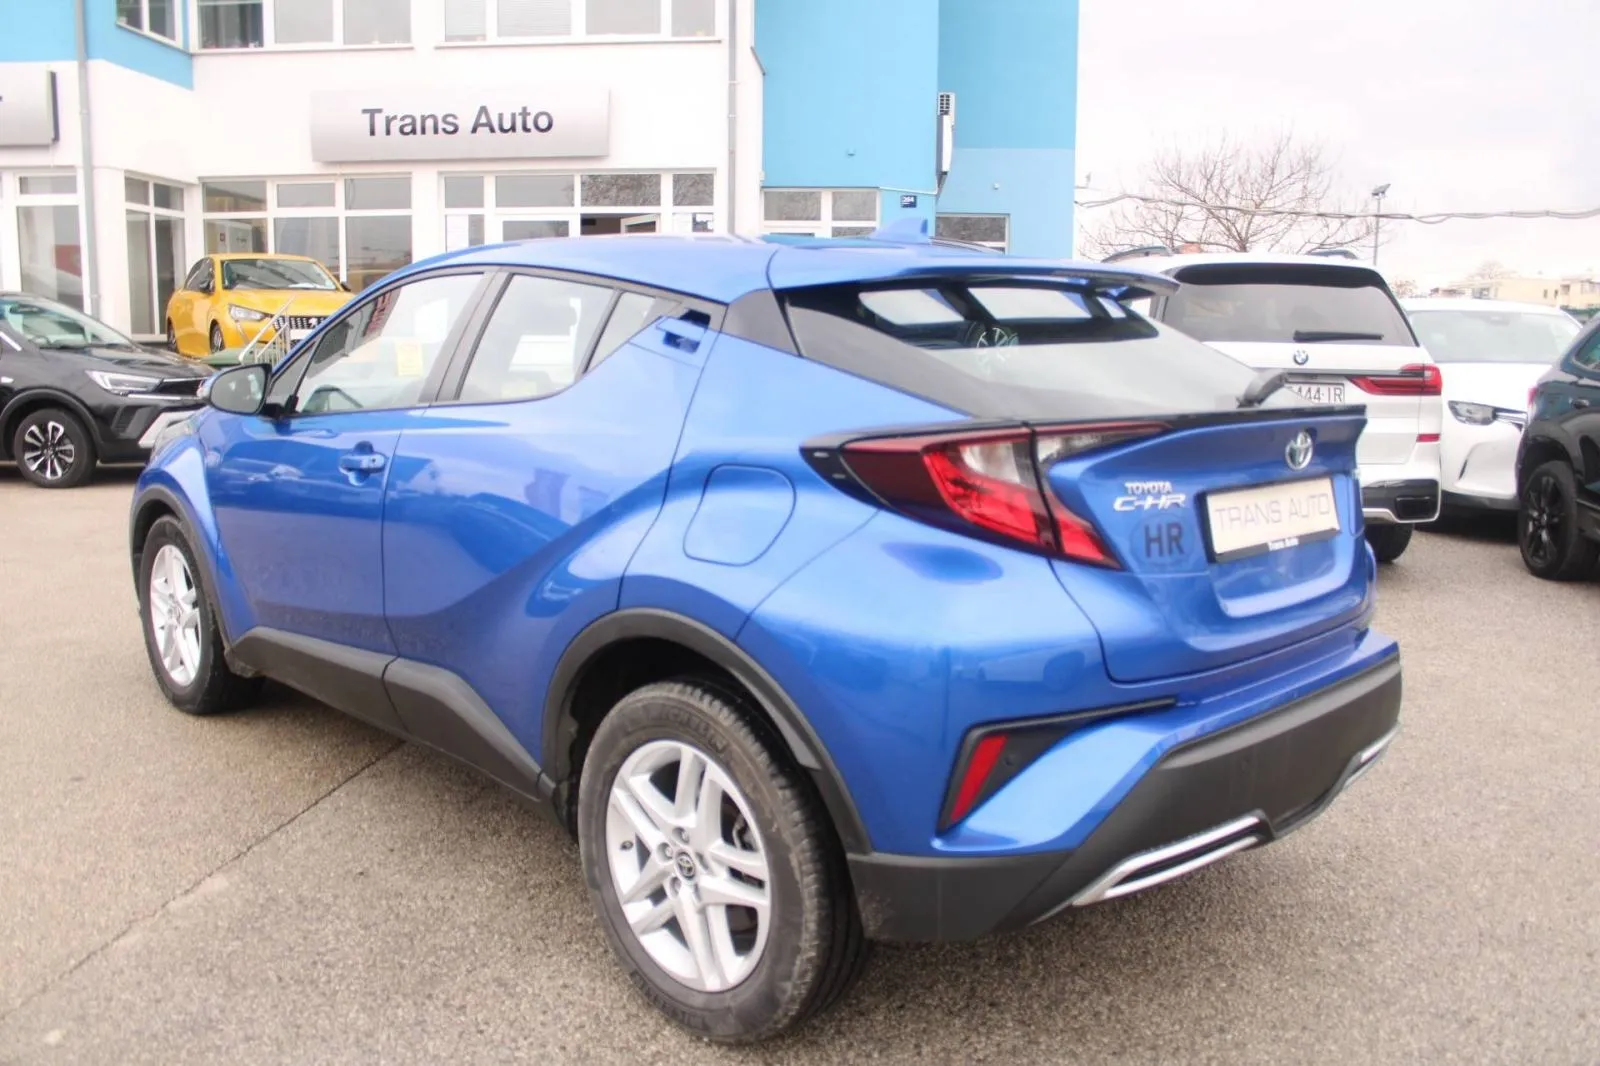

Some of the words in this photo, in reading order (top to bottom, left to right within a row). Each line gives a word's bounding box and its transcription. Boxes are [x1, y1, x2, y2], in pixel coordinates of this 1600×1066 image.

[361, 107, 459, 137] Trans
[470, 105, 554, 134] Auto
[1113, 493, 1186, 512] C-HR
[1124, 481, 1173, 495] TOYOTA
[1214, 500, 1283, 531] TRANS
[1288, 493, 1331, 520] AUTO
[1144, 522, 1185, 558] HR
